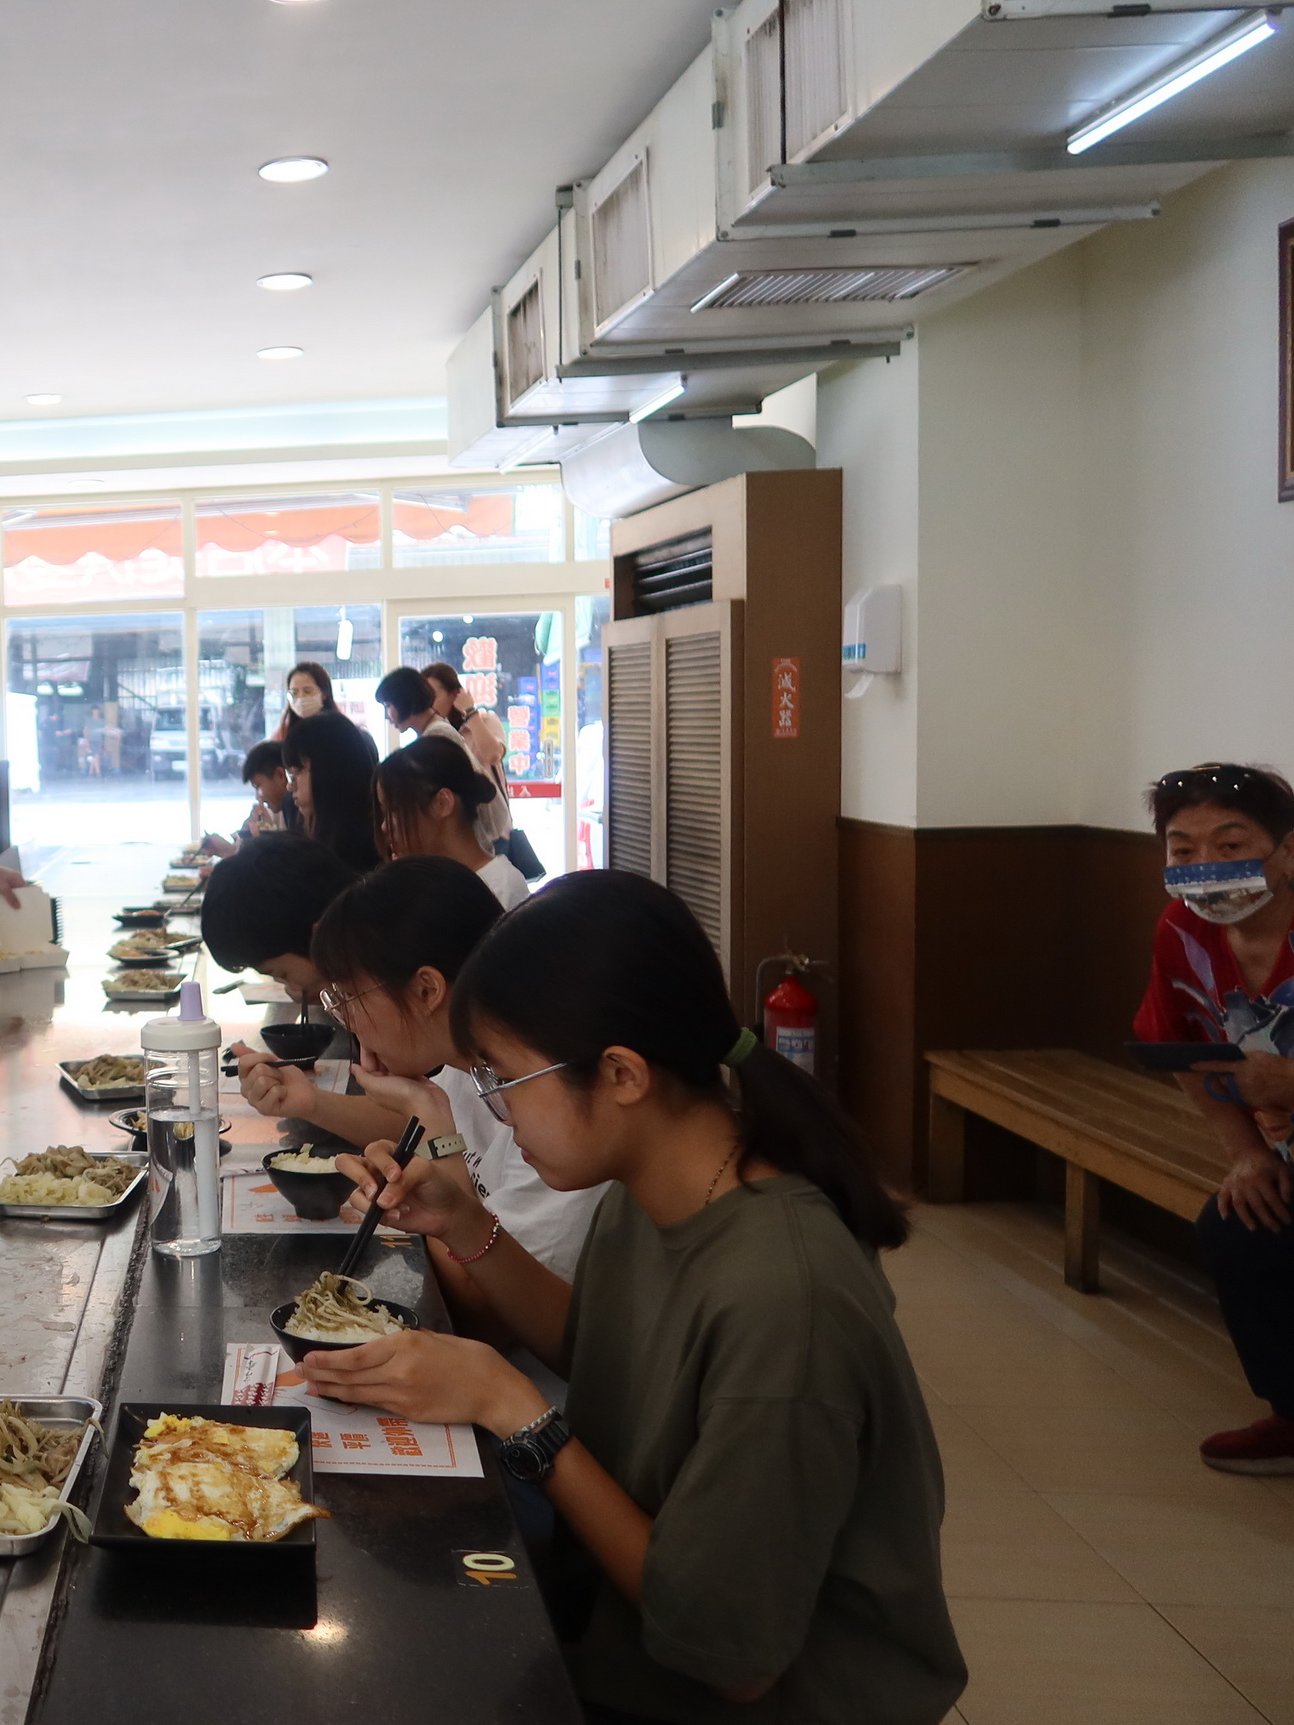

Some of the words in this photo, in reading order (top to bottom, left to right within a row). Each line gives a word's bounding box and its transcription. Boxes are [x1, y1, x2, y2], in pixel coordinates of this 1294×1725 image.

[777, 672, 797, 727] 滅火器
[462, 1552, 517, 1585] 10
